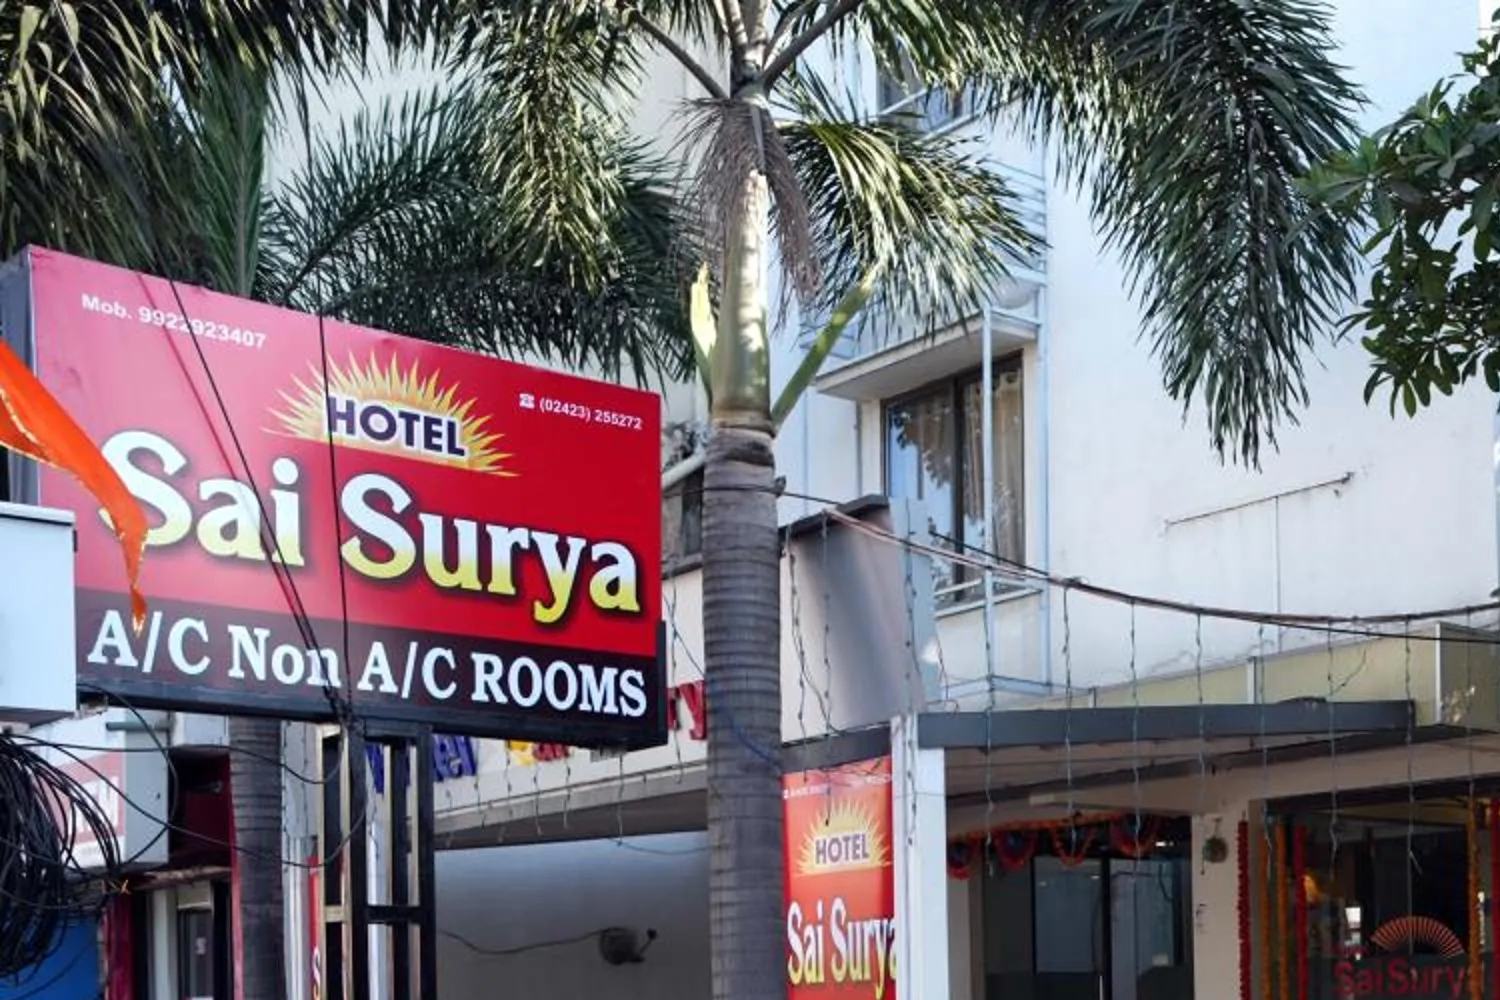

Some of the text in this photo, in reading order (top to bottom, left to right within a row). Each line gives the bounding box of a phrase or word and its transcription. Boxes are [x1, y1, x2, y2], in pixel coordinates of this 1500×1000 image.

[81, 294, 266, 348] Mob. 9922923407
[328, 396, 465, 457] HOTEL
[540, 398, 643, 430] (02423) 255272
[99, 431, 640, 623] Sai Surya
[87, 610, 211, 675] A/C
[227, 624, 341, 687] Non
[357, 641, 457, 699] A/C
[471, 652, 647, 717] ROOMS
[815, 834, 869, 864] HOTEL
[787, 901, 825, 985] Sai
